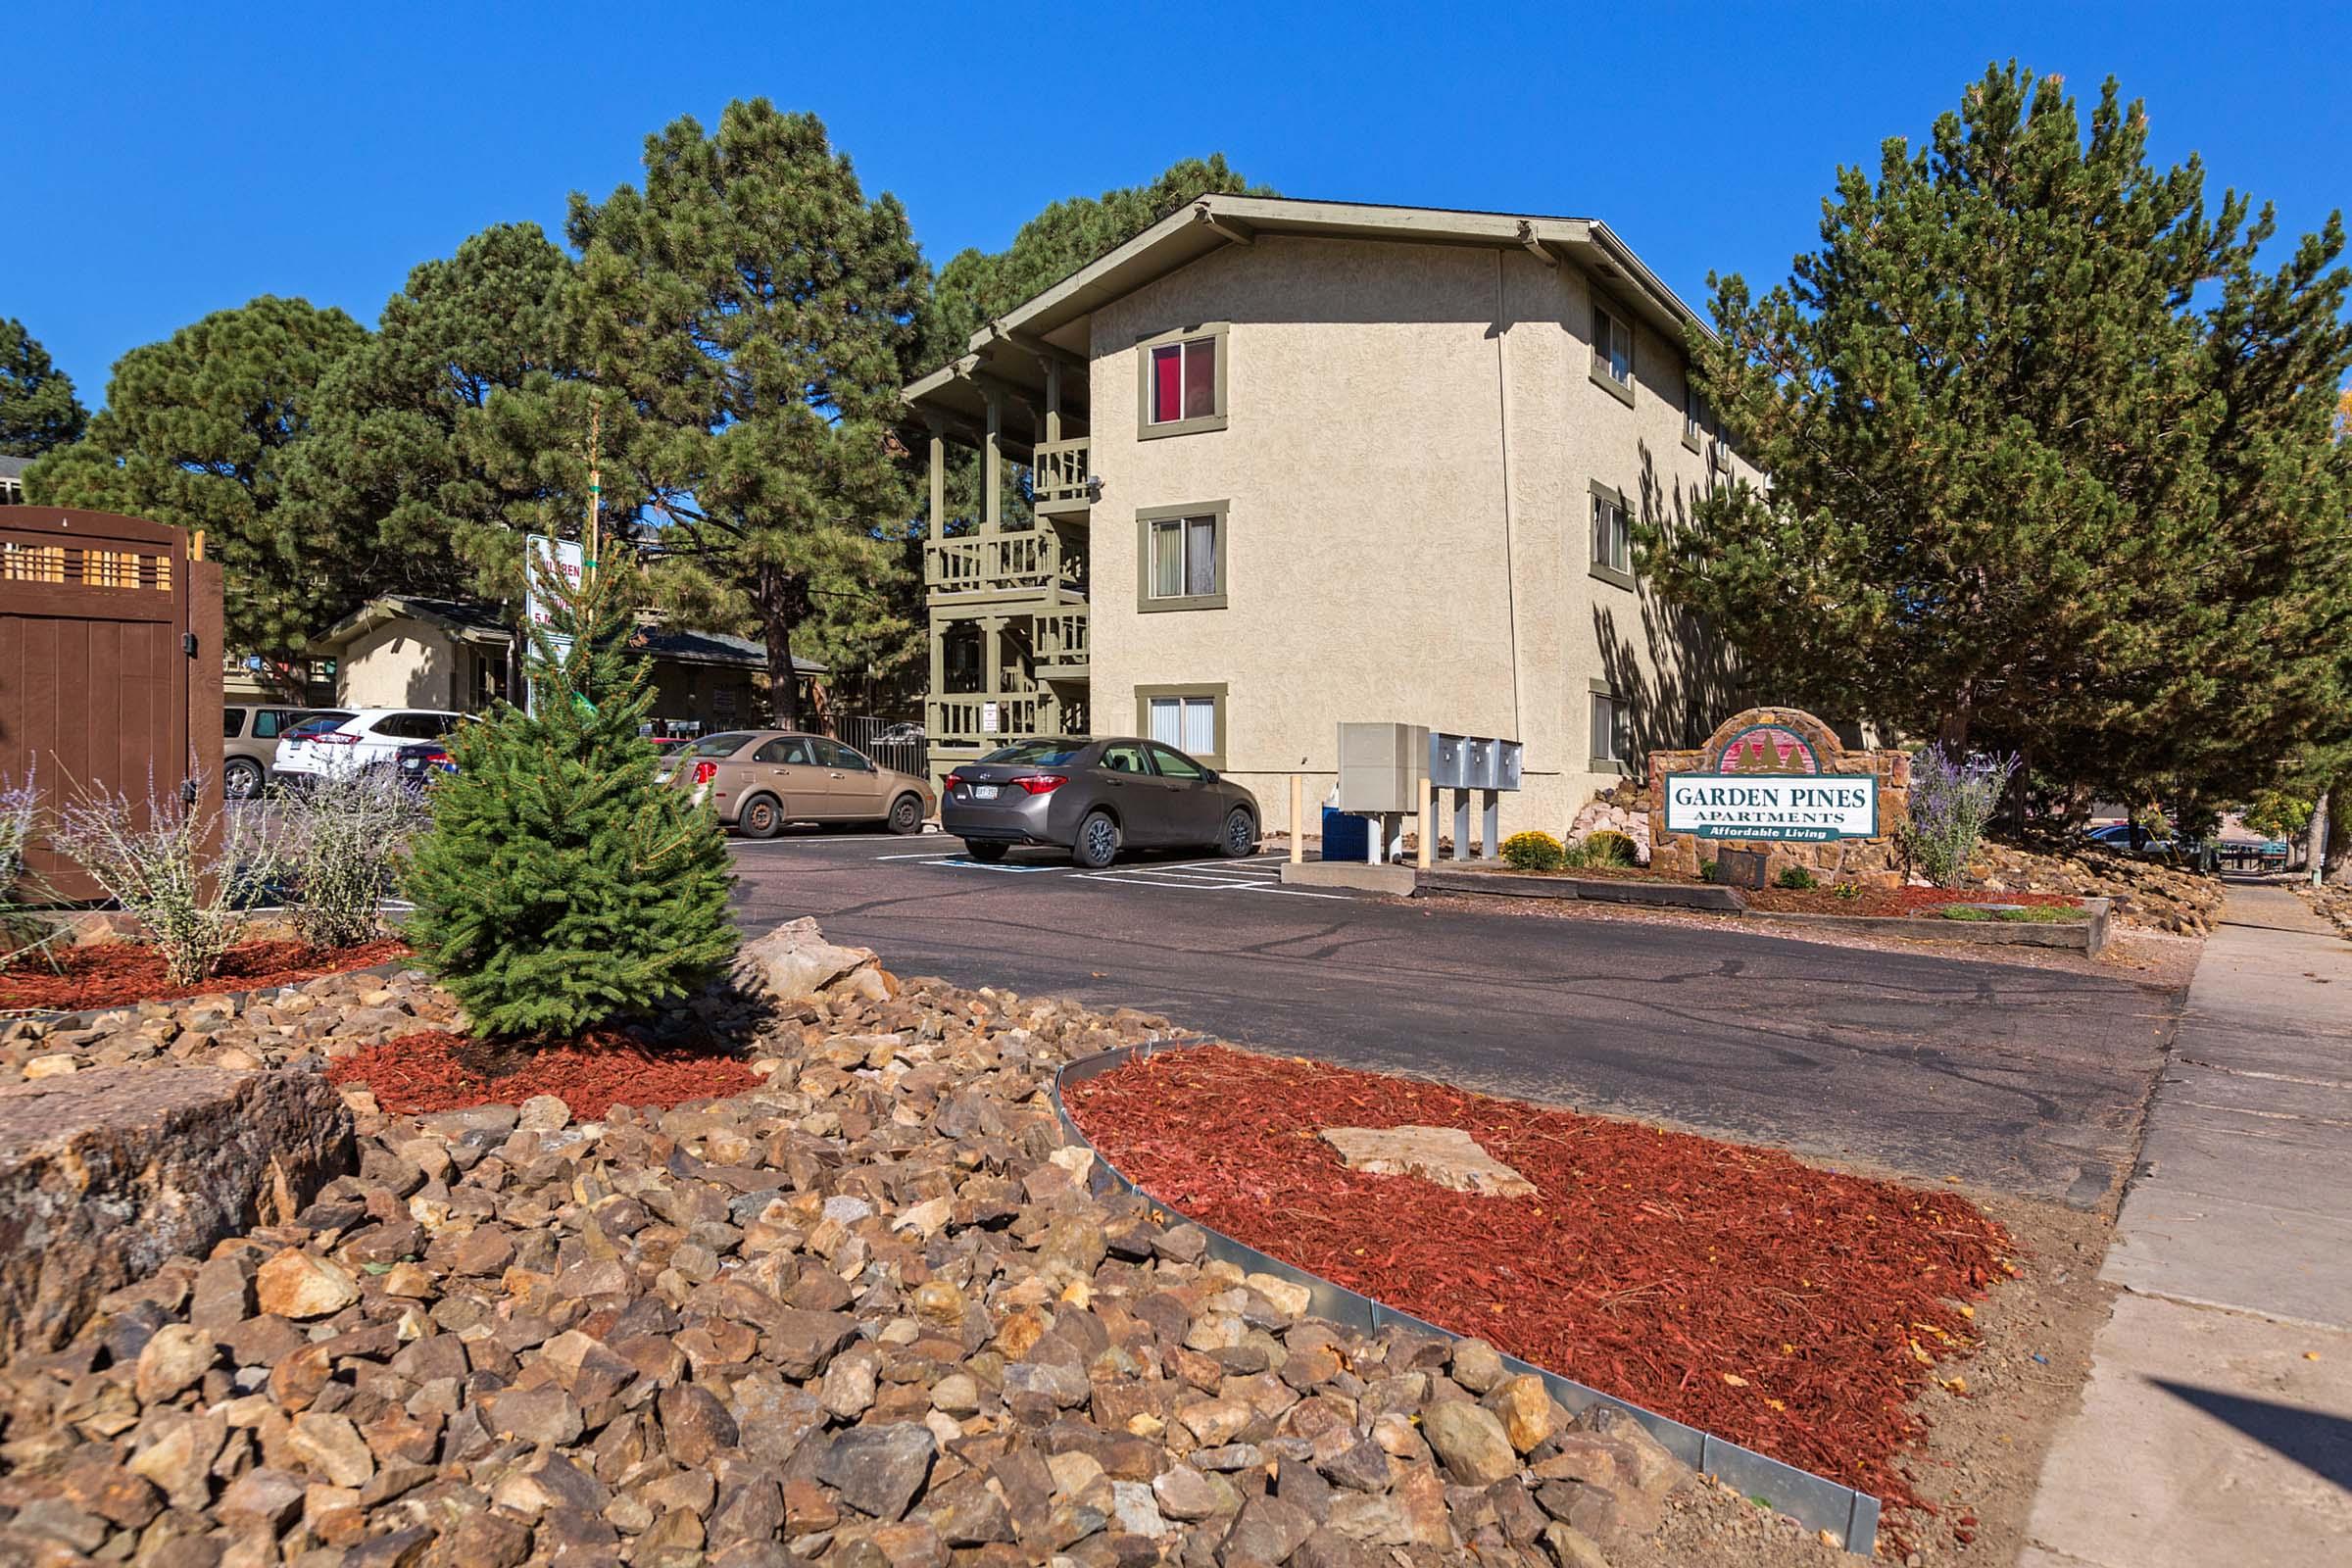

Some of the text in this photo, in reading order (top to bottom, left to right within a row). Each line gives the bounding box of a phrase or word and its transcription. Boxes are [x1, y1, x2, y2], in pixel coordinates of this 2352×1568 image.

[1675, 787, 1866, 808] GARDEN PINES
[1693, 810, 1845, 824] APARTMENTS
[1710, 825, 1827, 840] Affordable Living
